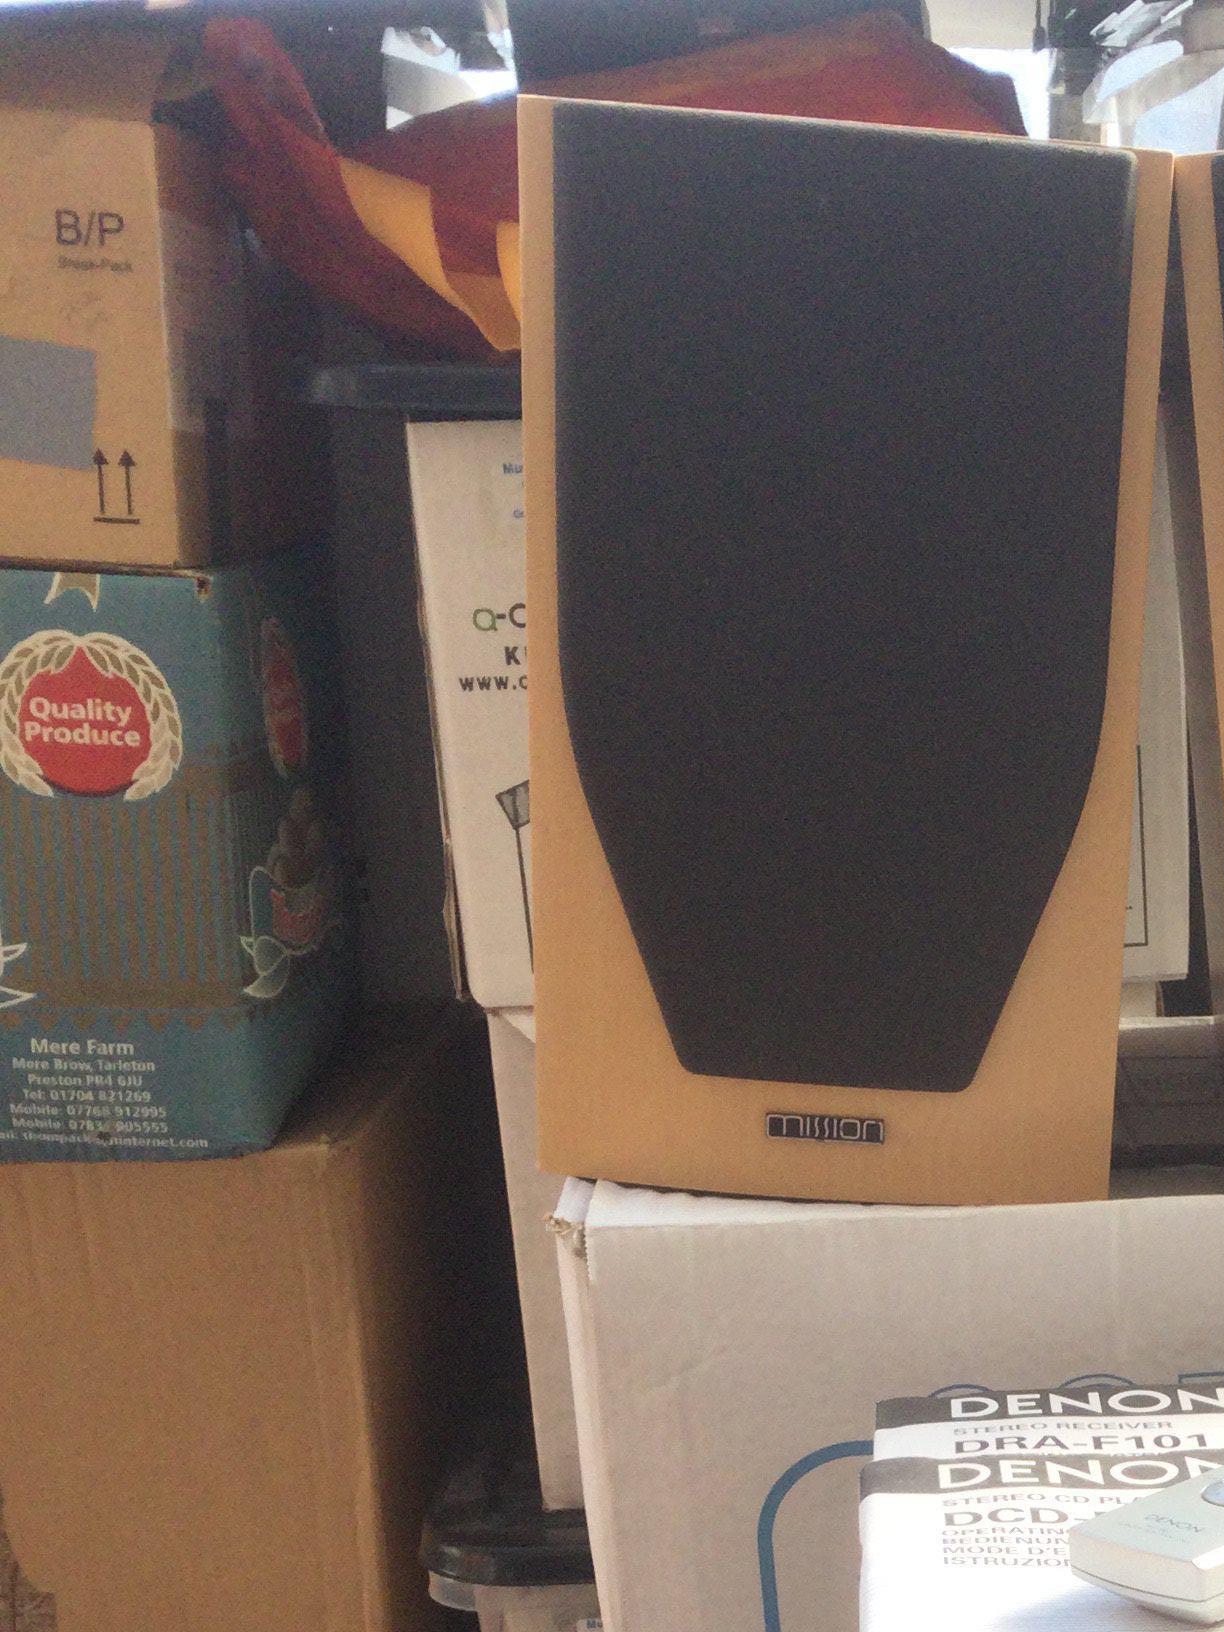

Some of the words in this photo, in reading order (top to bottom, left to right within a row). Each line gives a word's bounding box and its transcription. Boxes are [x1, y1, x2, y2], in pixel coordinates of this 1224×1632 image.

[54, 208, 124, 246] B/P
[29, 697, 132, 727] Quality
[24, 721, 141, 748] Produce
[30, 1038, 81, 1054] Mere
[87, 1039, 134, 1056] Farm
[953, 1422, 1049, 1436] STEREO
[1055, 1420, 1173, 1431] RECEIVER
[954, 1433, 1208, 1454] DRA-F101
[942, 1493, 1046, 1507] STEREO
[1054, 1494, 1090, 1504] CD
[943, 1546, 1019, 1556] MODE
